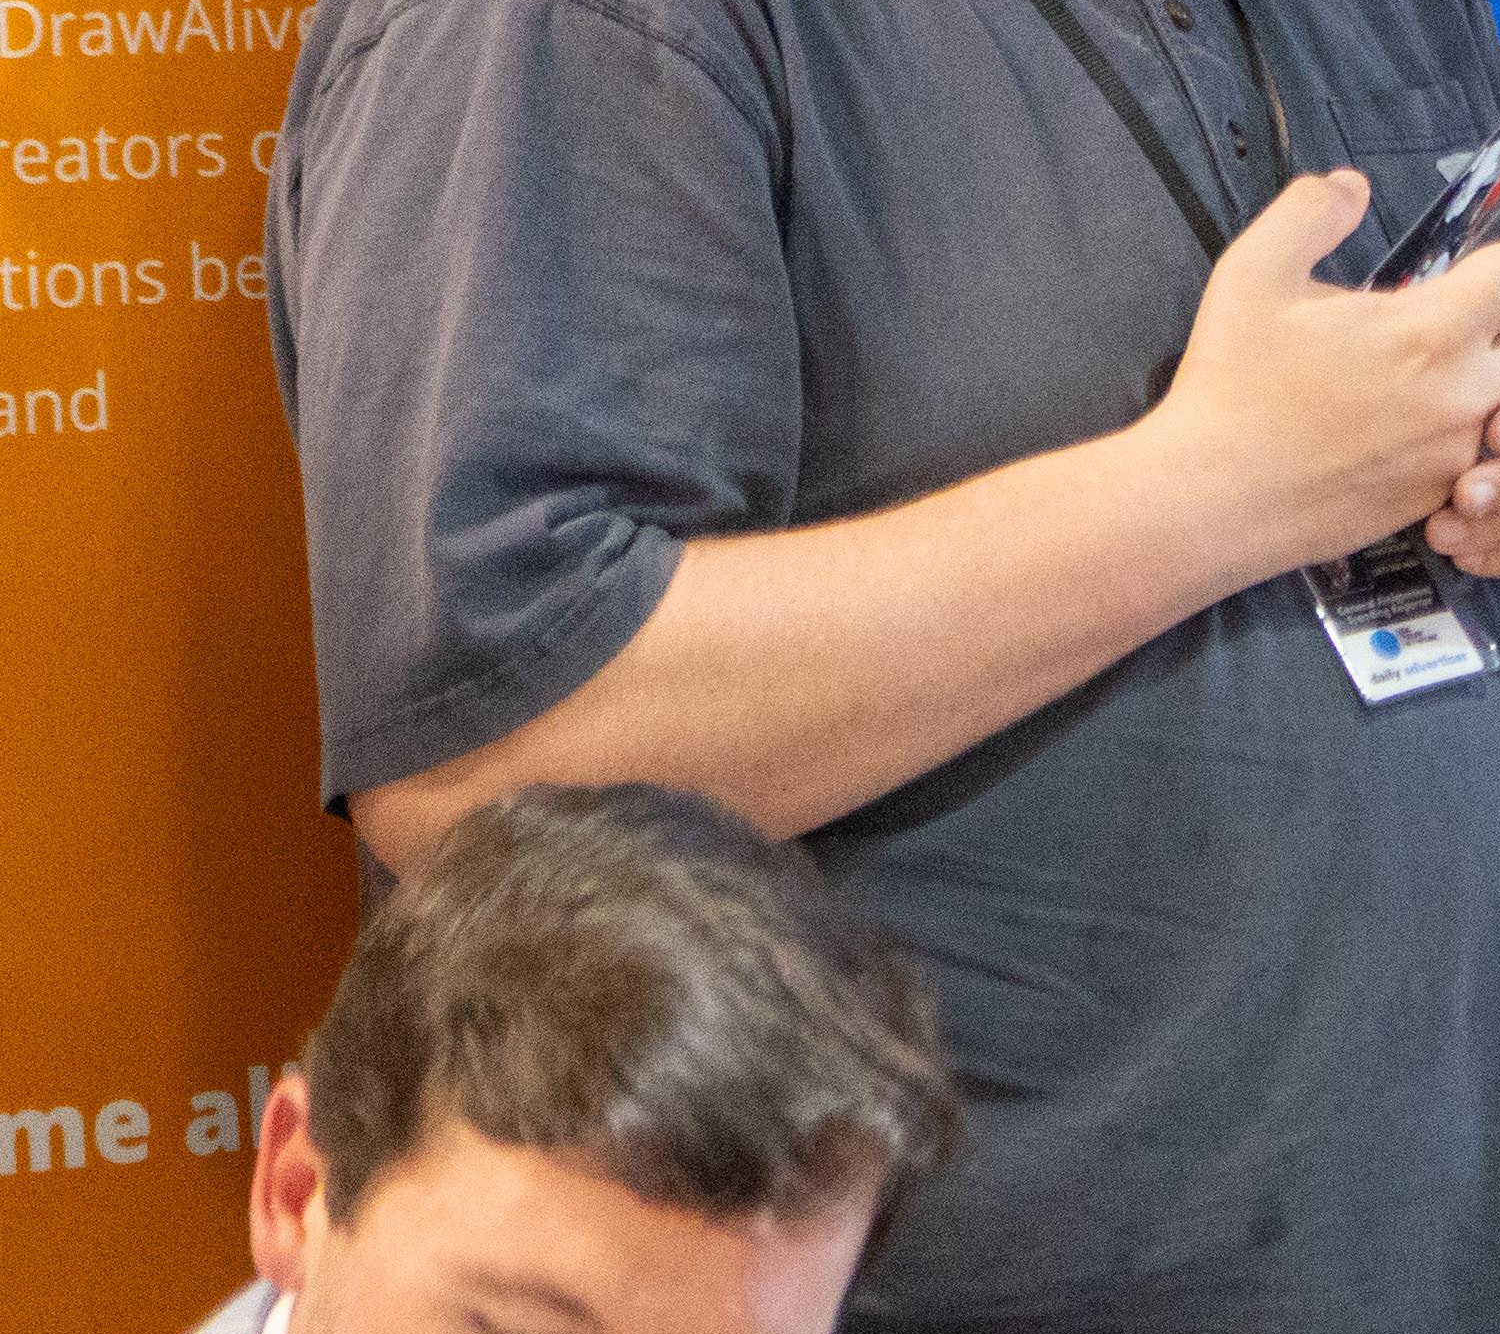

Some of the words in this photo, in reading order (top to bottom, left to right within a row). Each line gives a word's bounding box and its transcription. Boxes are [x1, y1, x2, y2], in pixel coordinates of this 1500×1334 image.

[0, 127, 228, 185] eators
[0, 249, 168, 311] tions
[191, 239, 269, 303] be
[186, 1060, 303, 1157] al
